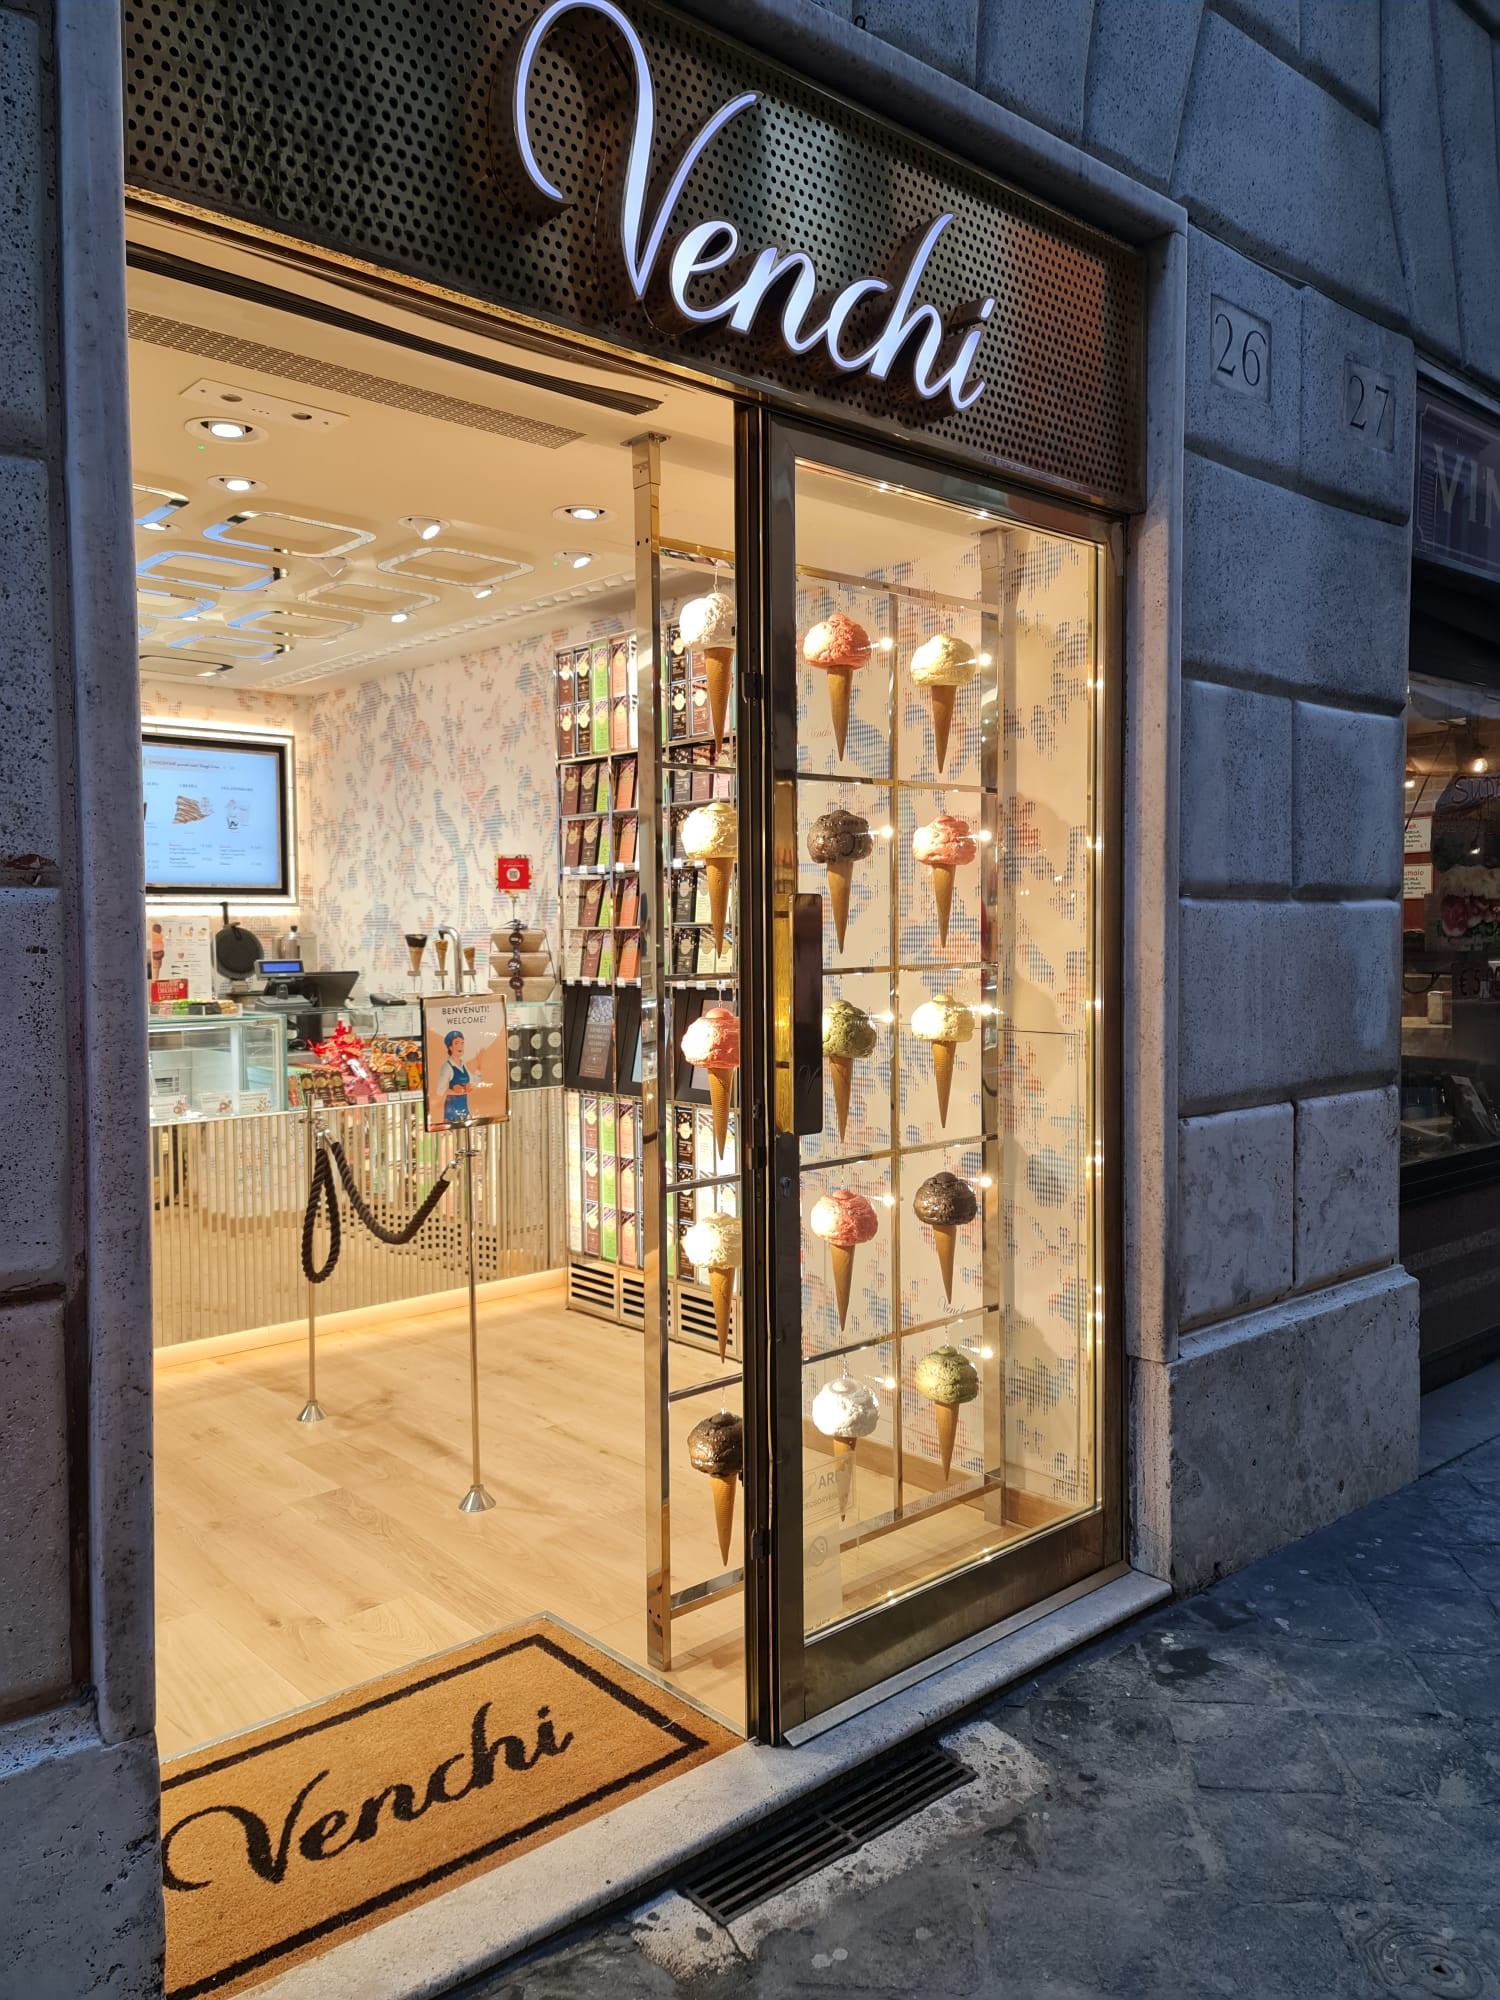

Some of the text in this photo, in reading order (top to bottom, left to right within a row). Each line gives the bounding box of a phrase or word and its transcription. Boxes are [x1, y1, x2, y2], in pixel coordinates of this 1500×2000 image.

[514, 0, 995, 411] Venchi
[1214, 312, 1267, 387] 26
[1348, 374, 1392, 438] 27
[441, 1004, 490, 1015] BENVENUTI!
[446, 1015, 487, 1025] WELCOME!
[161, 1701, 575, 1892] Venchi
